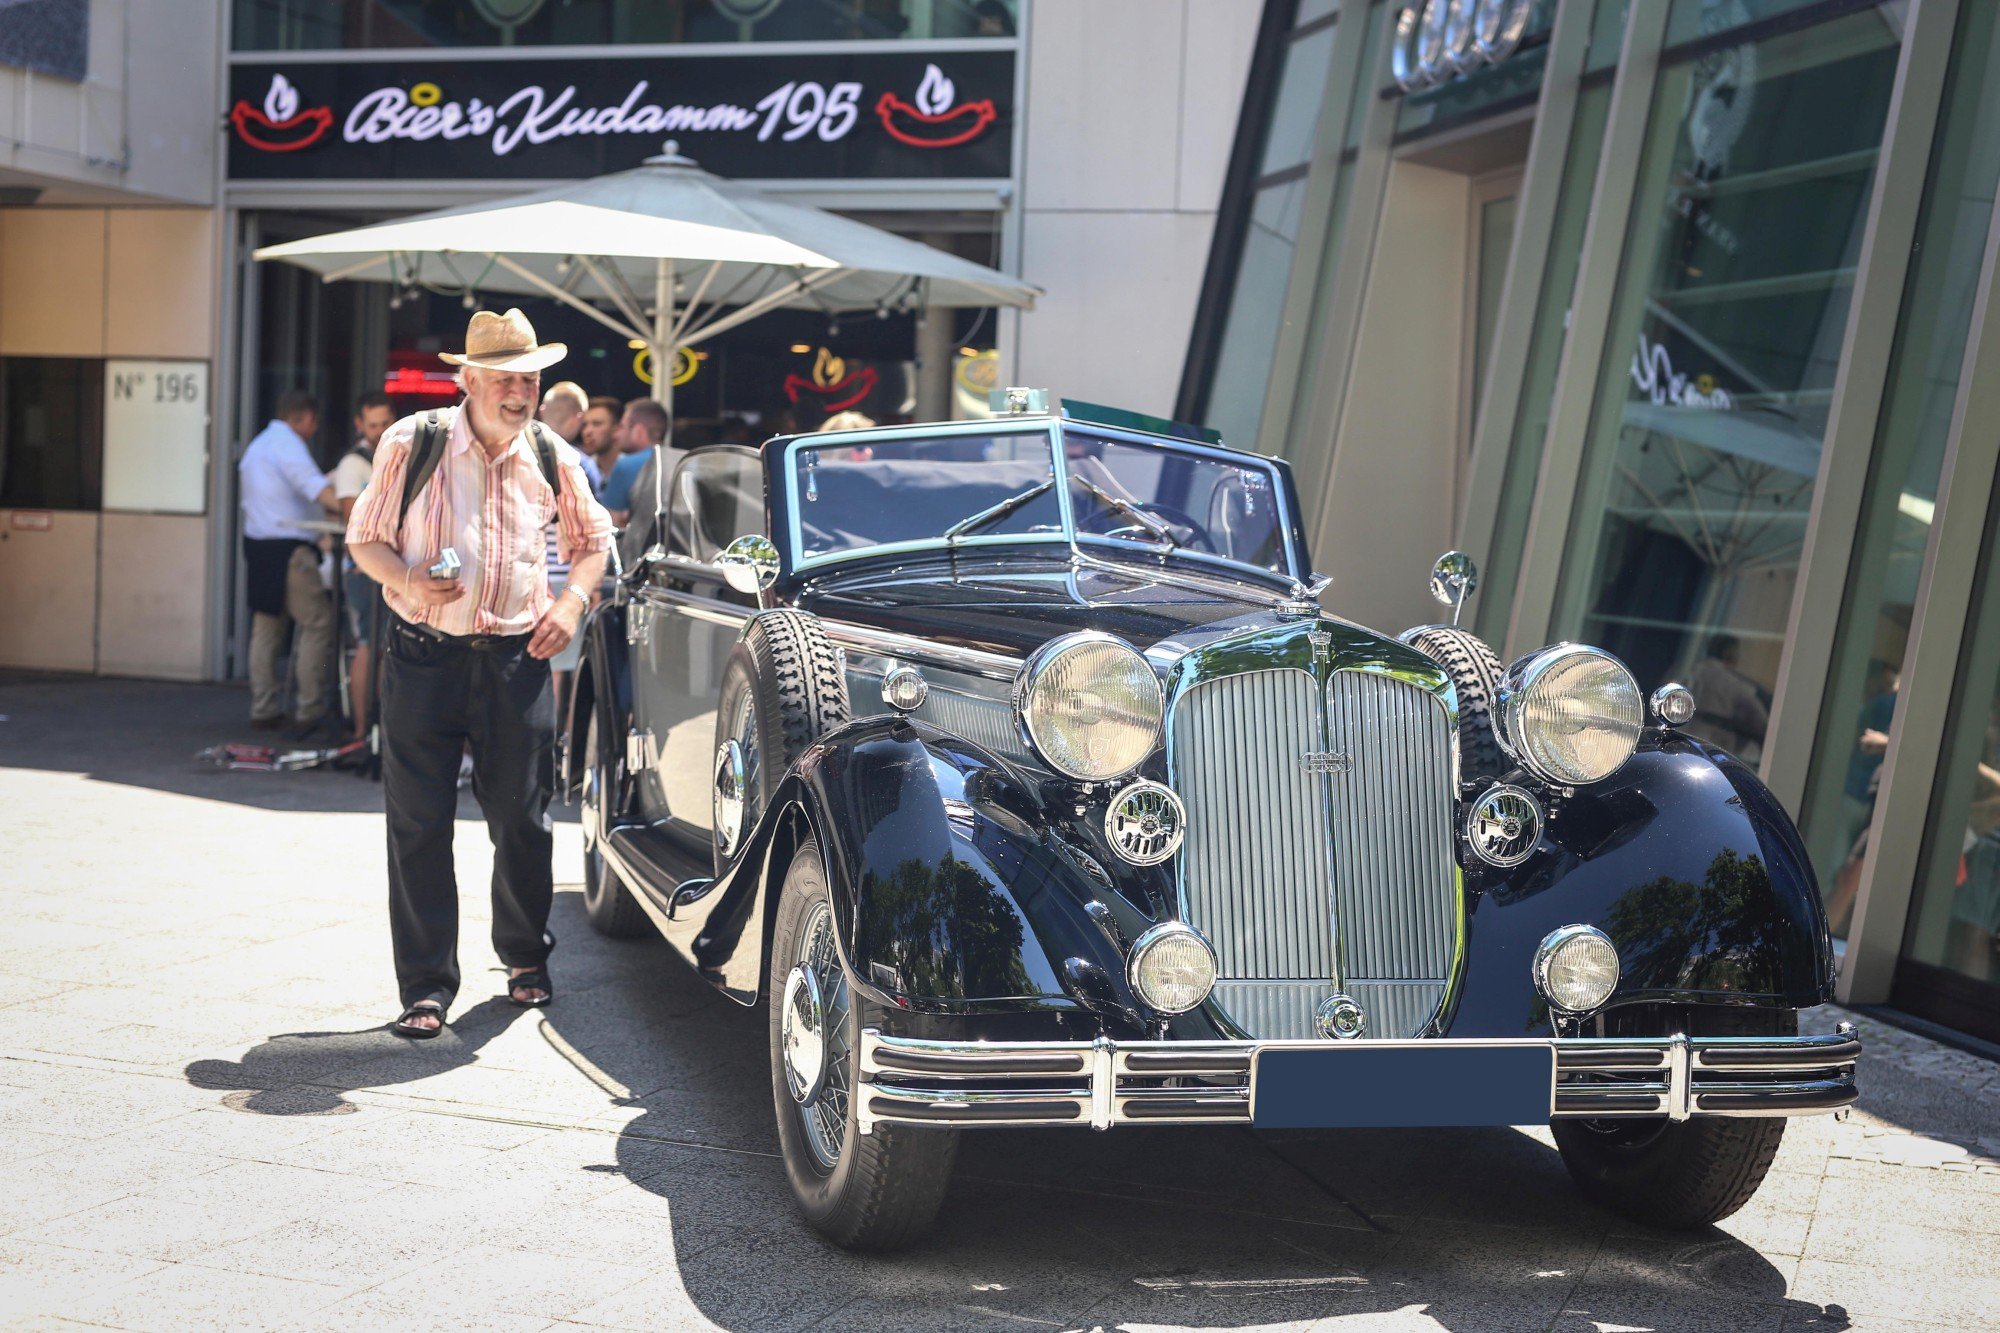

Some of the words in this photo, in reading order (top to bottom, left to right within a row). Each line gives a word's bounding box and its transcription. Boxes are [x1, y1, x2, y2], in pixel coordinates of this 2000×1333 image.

[343, 82, 494, 143] Bier's
[493, 80, 758, 156] Kudamm
[756, 81, 863, 142] 195
[154, 373, 199, 402] 196
